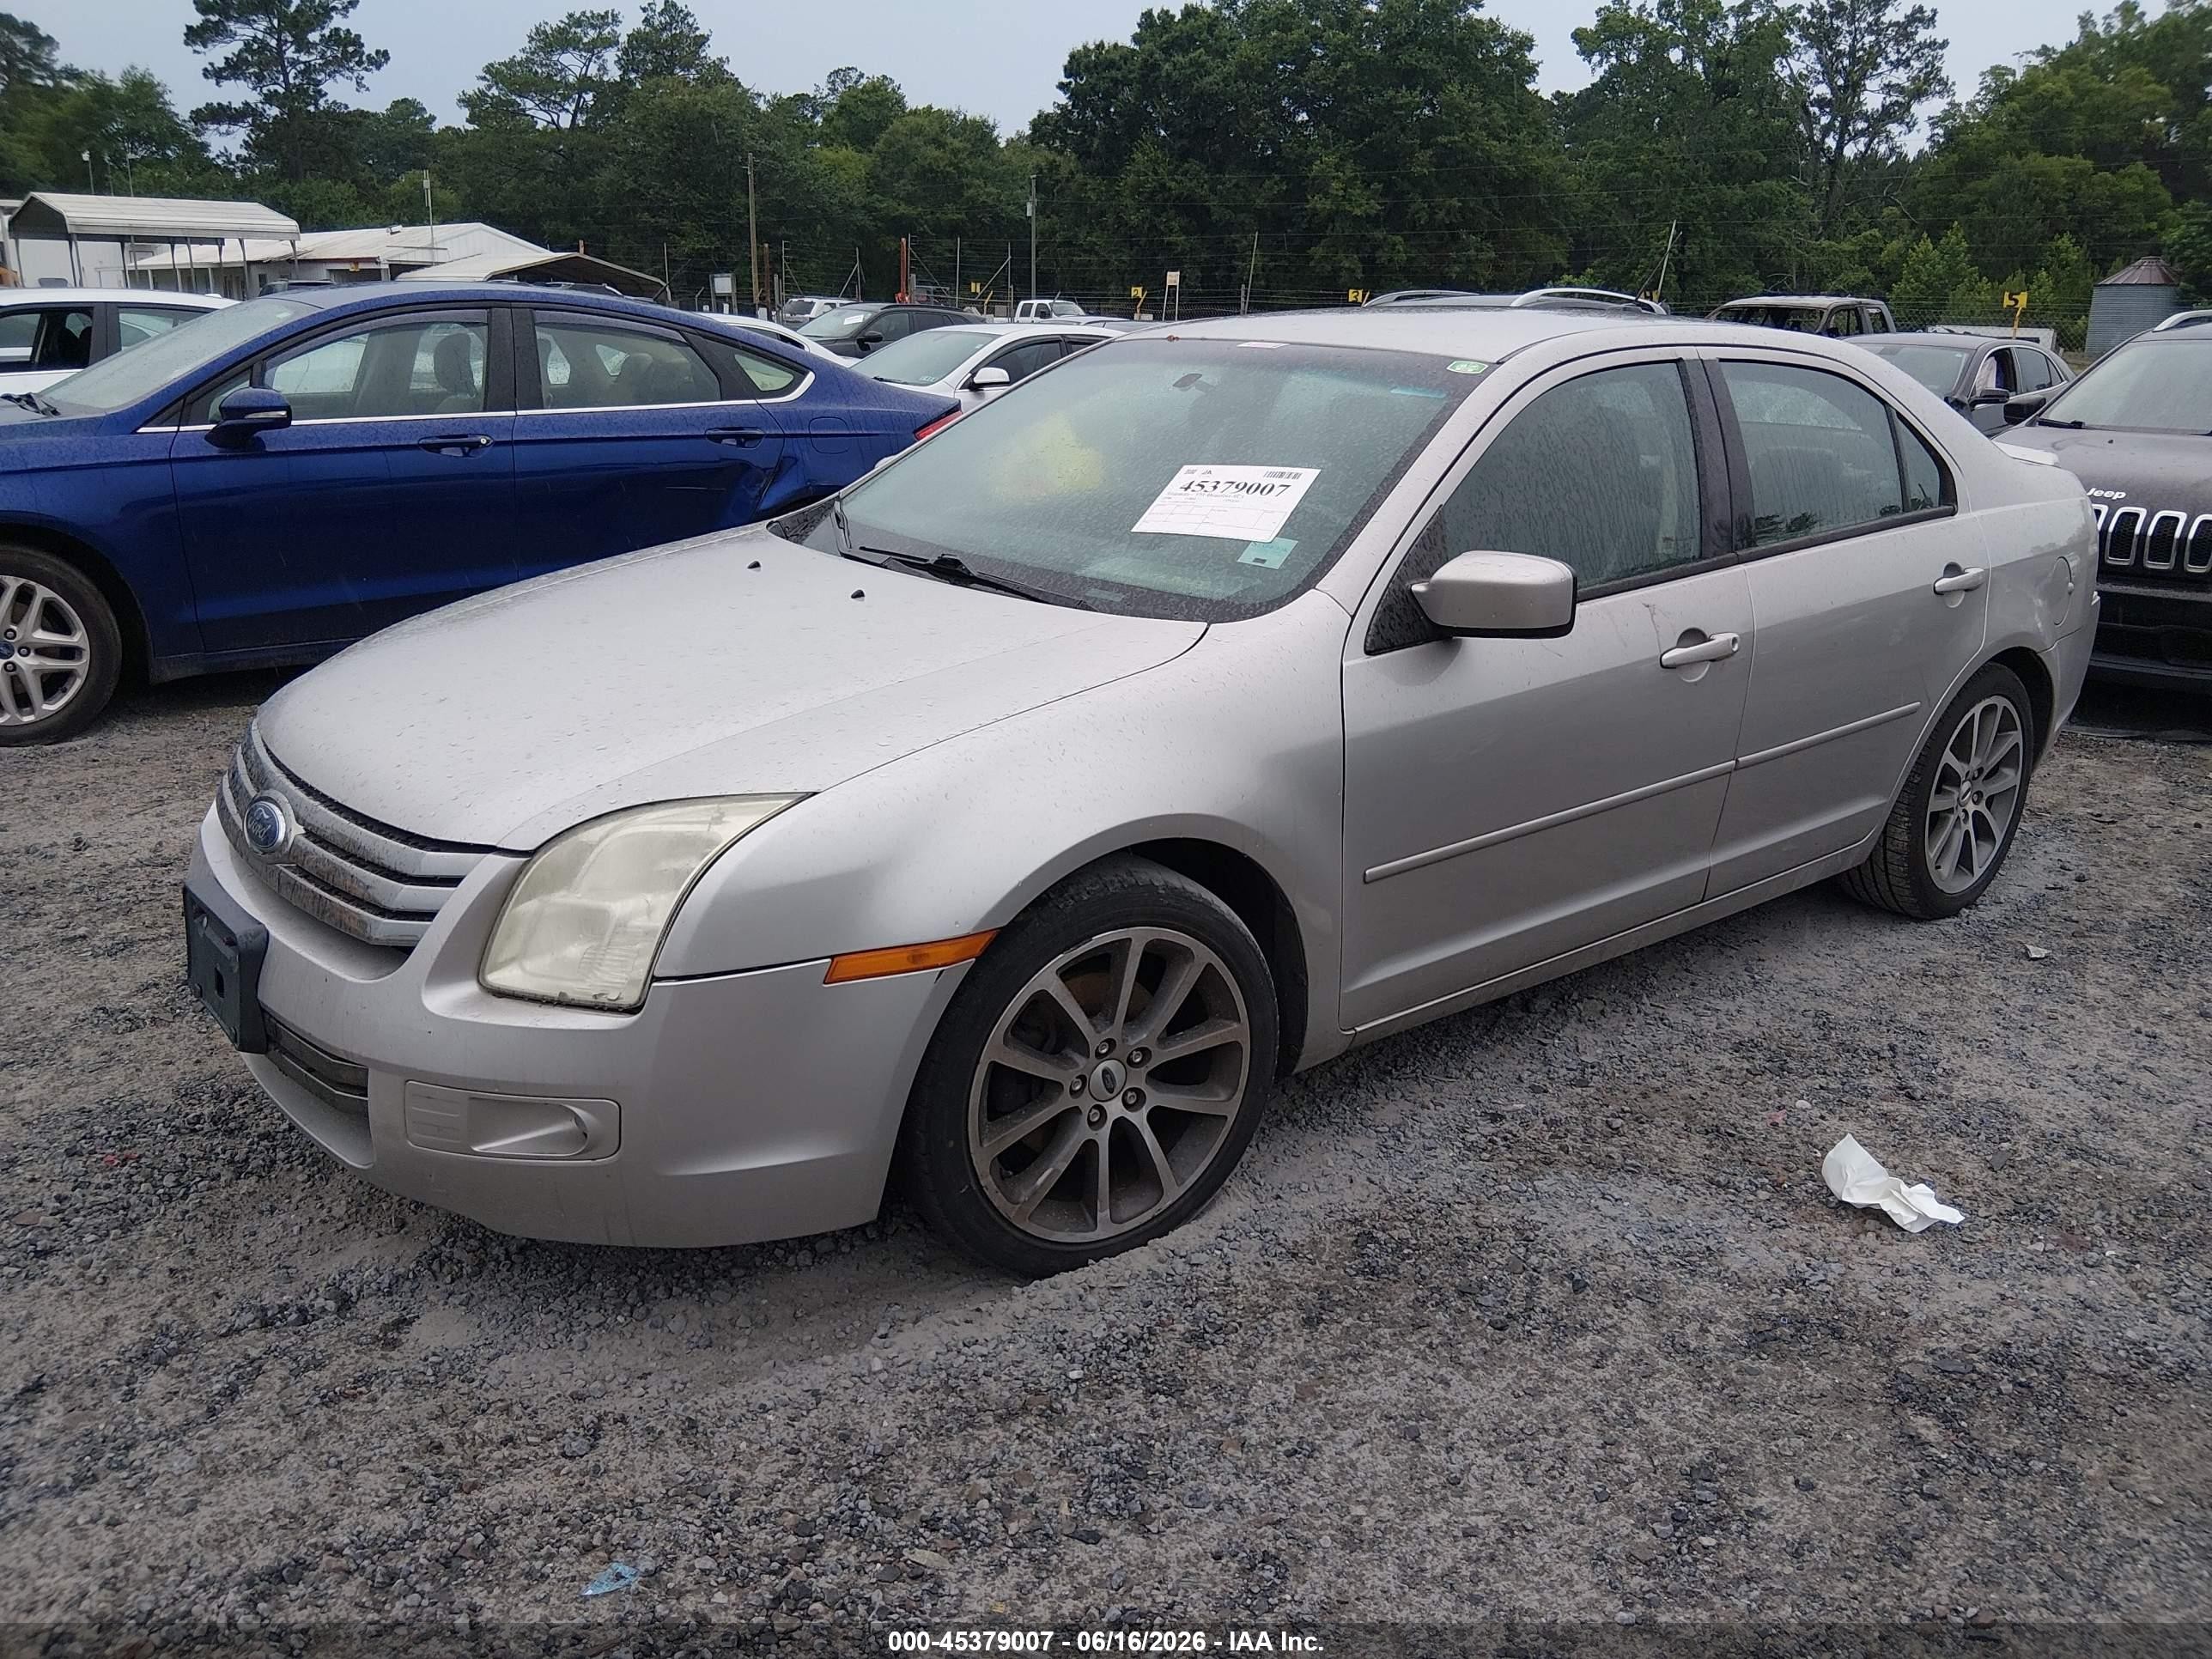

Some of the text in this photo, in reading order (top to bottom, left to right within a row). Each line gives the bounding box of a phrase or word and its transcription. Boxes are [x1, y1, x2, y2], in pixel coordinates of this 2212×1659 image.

[1133, 289, 1139, 297] 2
[1352, 290, 1360, 302] 3
[2006, 293, 2020, 307] 5
[1180, 479, 1291, 497] 45379007
[2087, 487, 2127, 500] Jeep
[246, 807, 272, 842] Ford
